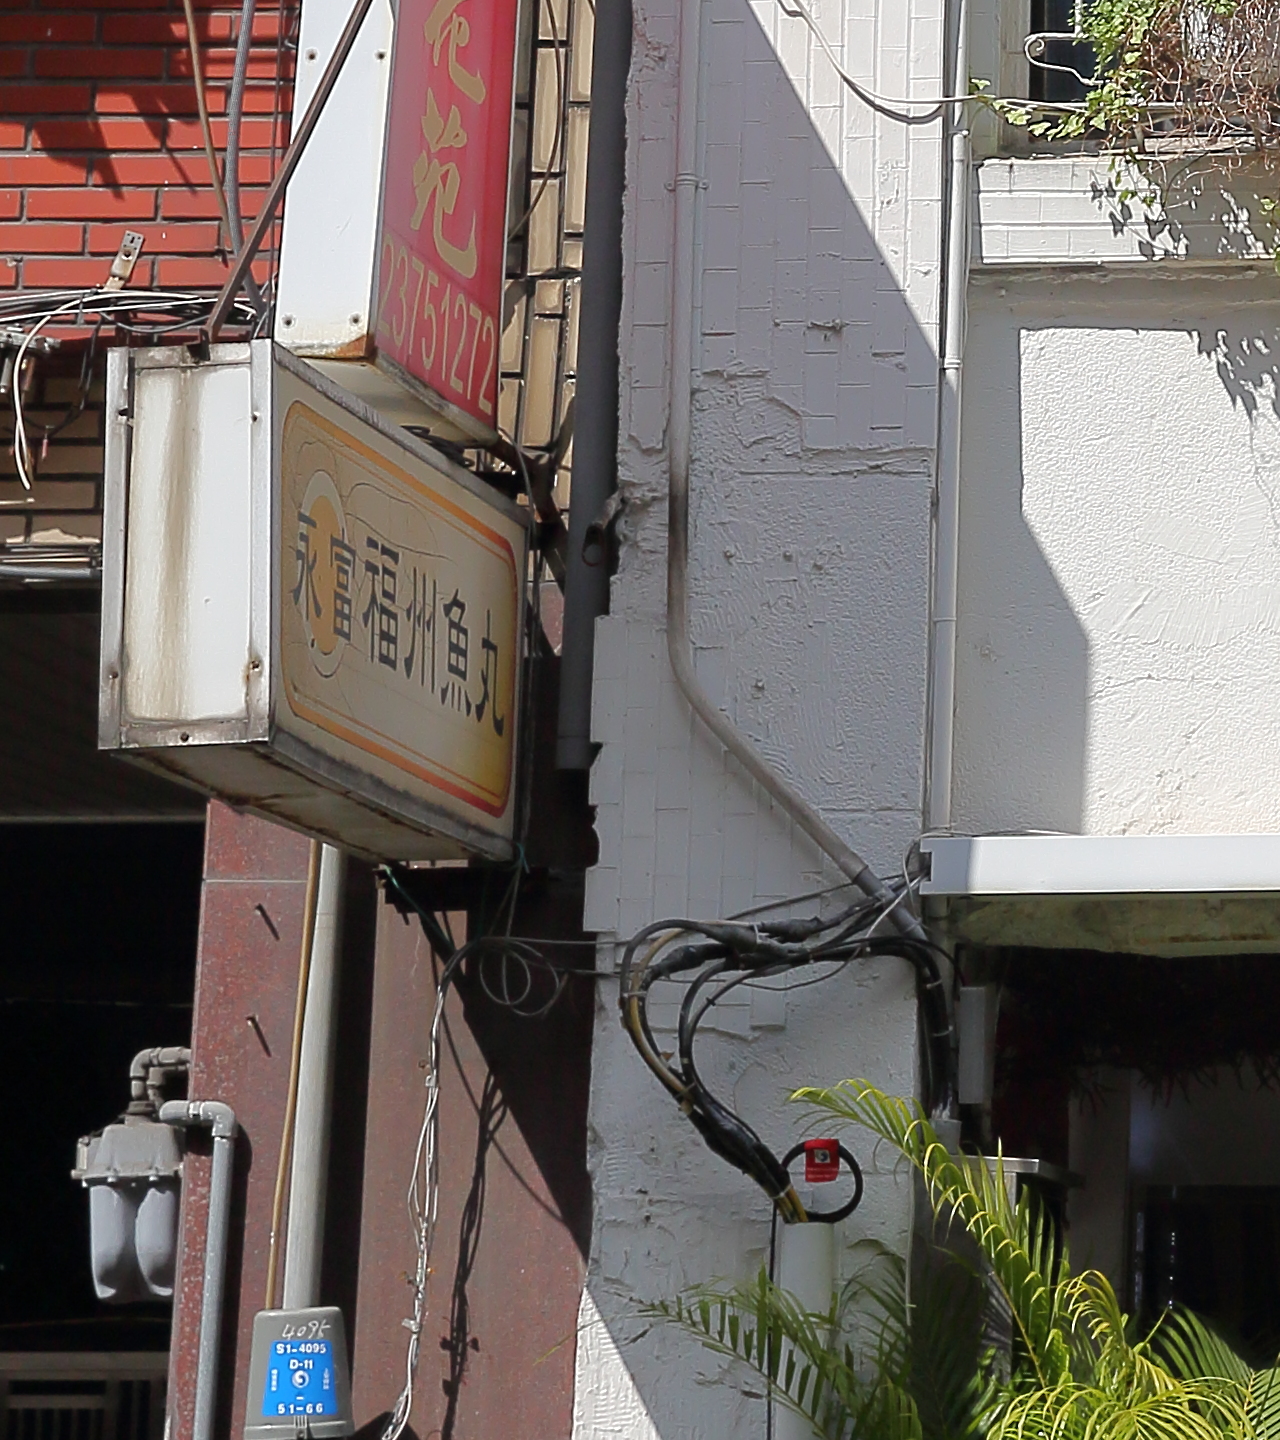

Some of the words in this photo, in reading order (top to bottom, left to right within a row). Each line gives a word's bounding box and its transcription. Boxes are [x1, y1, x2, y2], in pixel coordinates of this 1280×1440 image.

[377, 233, 495, 416] 23751272
[291, 510, 506, 738] 永富福州魚丸
[276, 1343, 327, 1354] S1-4095
[289, 1359, 314, 1370] D-11
